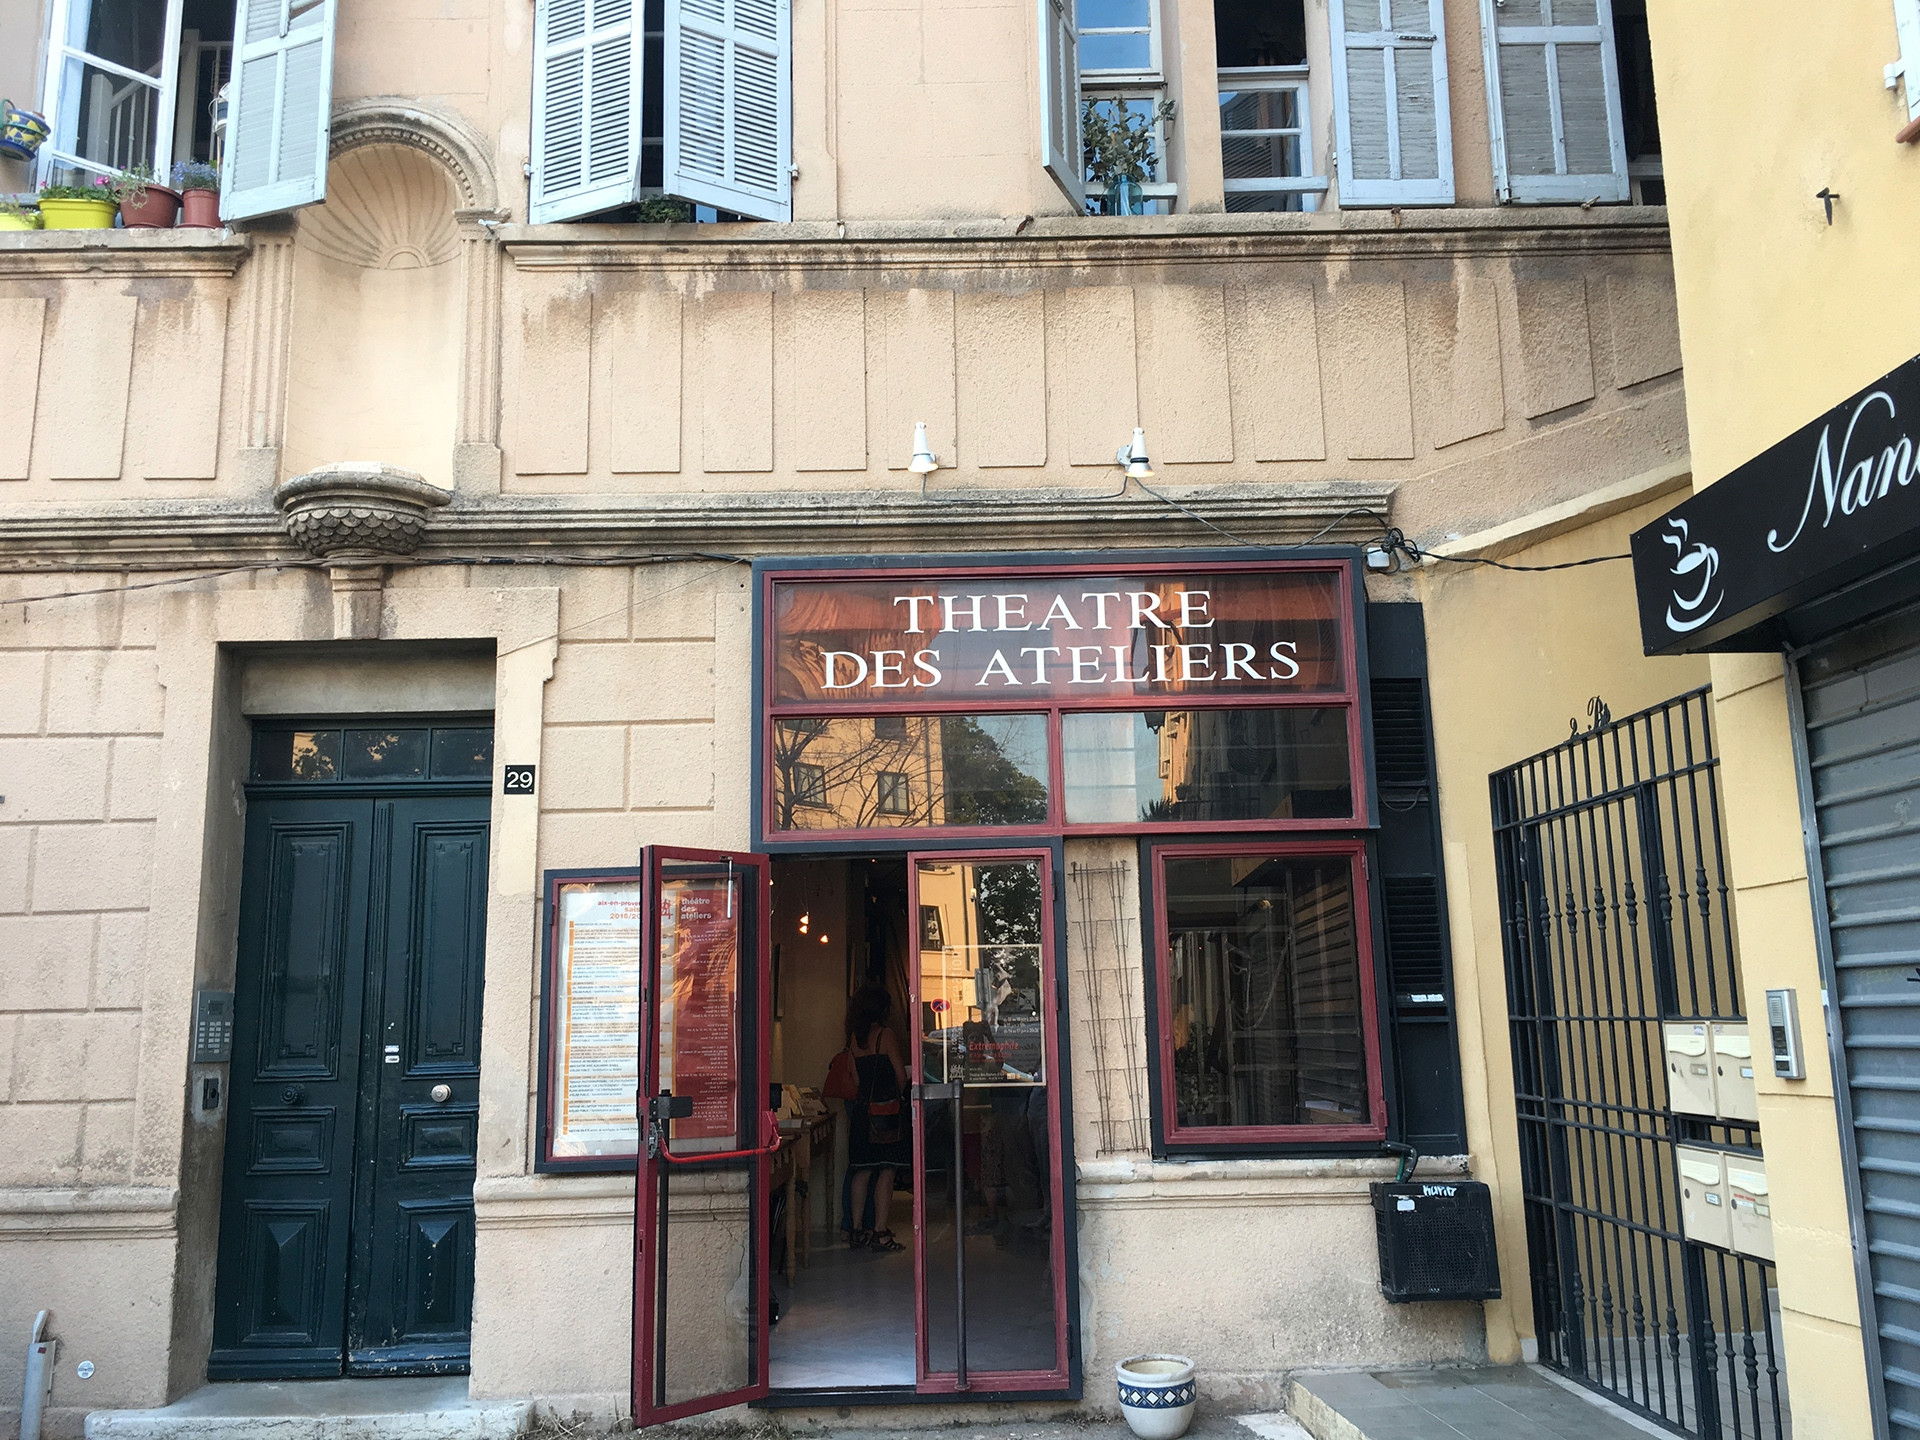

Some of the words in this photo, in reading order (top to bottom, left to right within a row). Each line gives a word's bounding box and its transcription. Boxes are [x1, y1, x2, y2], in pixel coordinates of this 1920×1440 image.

[1767, 391, 1920, 553] Nan
[893, 590, 1216, 635] THEATRE
[820, 648, 942, 690] DES
[975, 641, 1301, 687] ATELIERS
[507, 771, 533, 788] 29
[681, 896, 710, 905] théâtre
